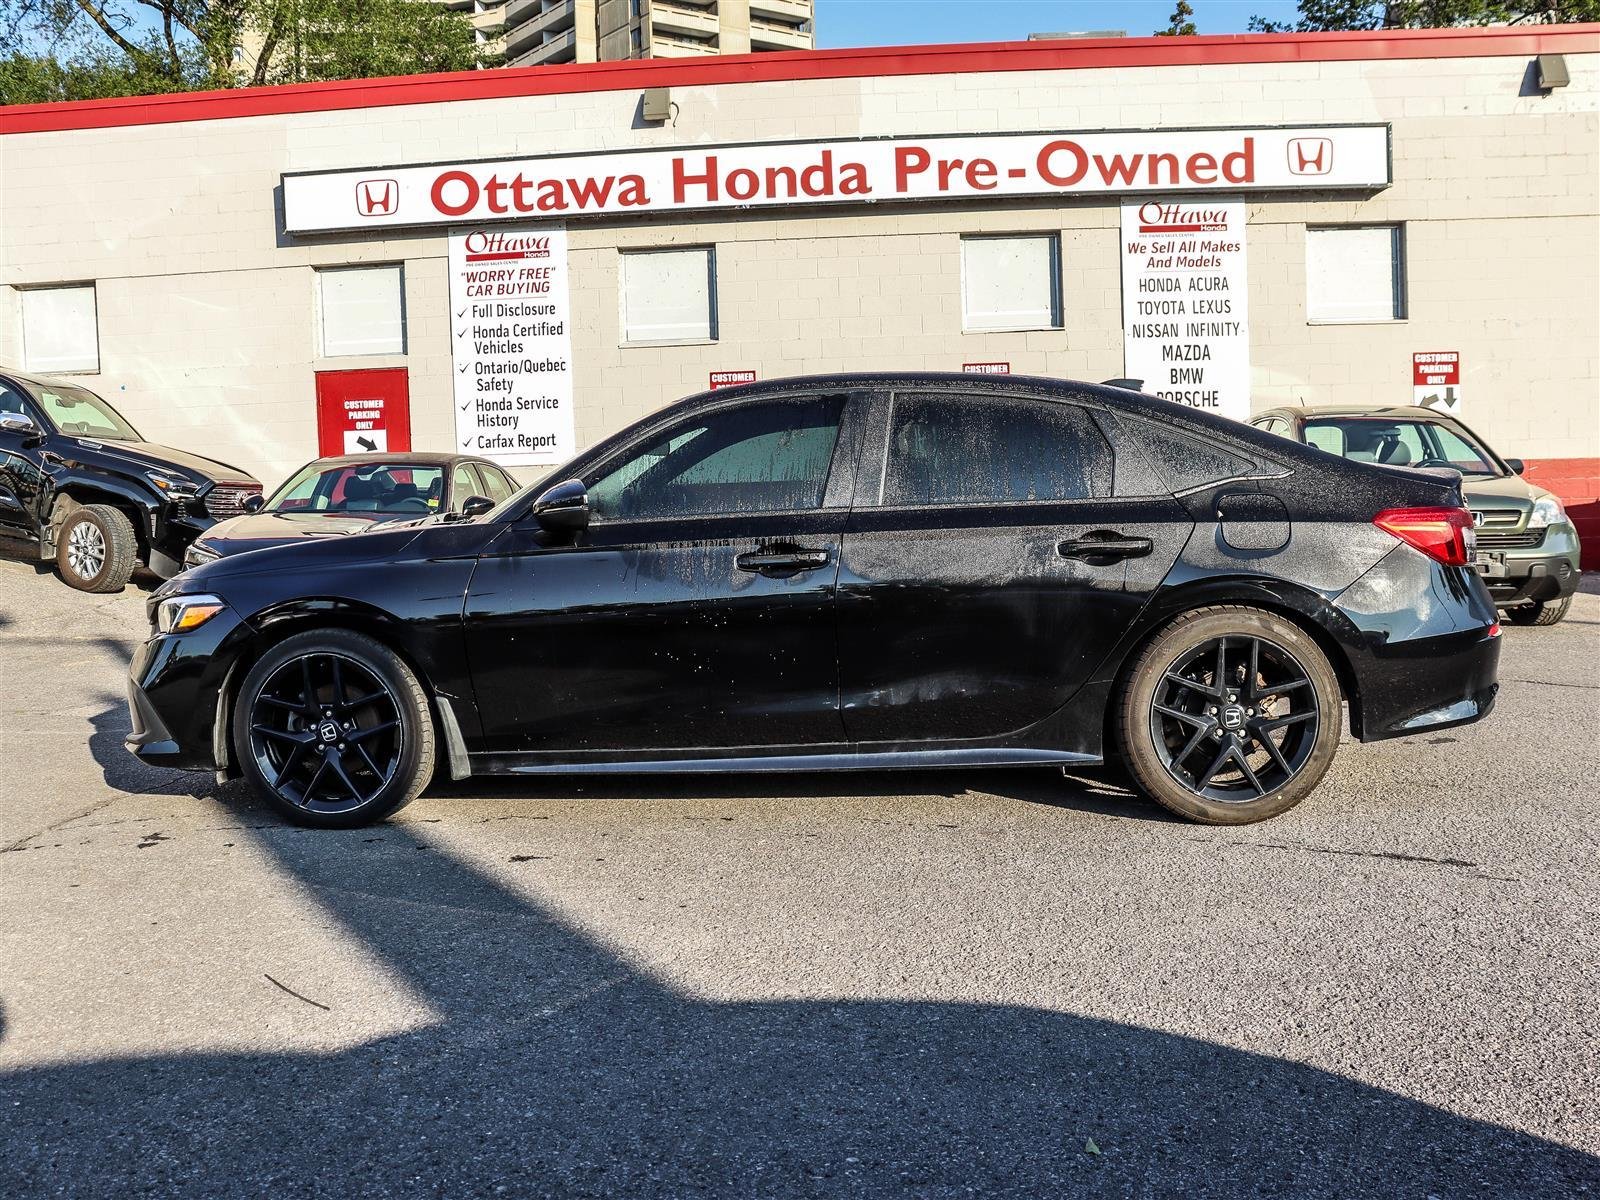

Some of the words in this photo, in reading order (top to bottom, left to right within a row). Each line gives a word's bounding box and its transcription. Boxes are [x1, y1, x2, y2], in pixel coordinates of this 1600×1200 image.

[430, 170, 650, 216] Ottawa
[672, 149, 873, 204] Honda
[894, 137, 1255, 193] Pre-Owned
[1139, 201, 1228, 224] Ottawa
[465, 230, 550, 253] Ottawa
[1128, 242, 1147, 254] We
[1151, 241, 1175, 253] Sell
[1178, 241, 1196, 253] All
[1200, 240, 1240, 252] Makes
[524, 250, 549, 258] Honda
[1147, 256, 1172, 268] And
[1176, 255, 1221, 268] Models
[466, 285, 493, 297] CAR
[497, 281, 550, 295] BUYING
[1139, 278, 1182, 292] HONDA
[1188, 277, 1229, 291] ACURA
[472, 304, 493, 318] Full
[496, 302, 556, 317] Disclosure
[1137, 300, 1185, 315] TOYOTA
[1192, 299, 1231, 314] LEXUS
[473, 323, 510, 338] Honda
[513, 321, 563, 337] Certified
[1132, 323, 1179, 338] NISSAN
[1186, 322, 1240, 337] INFINITY
[474, 339, 524, 354] Vehicles
[1162, 344, 1211, 361] MAZDA
[1414, 354, 1457, 362] CUSTOMER
[474, 358, 566, 375] Ontario/Quebec
[965, 365, 1008, 373] CUSTOMER
[1419, 365, 1453, 373] PARKING
[711, 372, 754, 382] CUSTOMER
[1170, 367, 1204, 384] BMW
[1426, 375, 1447, 384] ONLY
[476, 377, 513, 394] Safety
[344, 400, 384, 409] CUSTOMER
[476, 397, 512, 411] Honda
[516, 396, 559, 410] Service
[348, 411, 380, 419] PARKING
[477, 414, 519, 430] History
[355, 421, 373, 429] ONLY
[477, 434, 514, 449] Carfax
[518, 433, 557, 450] Report
